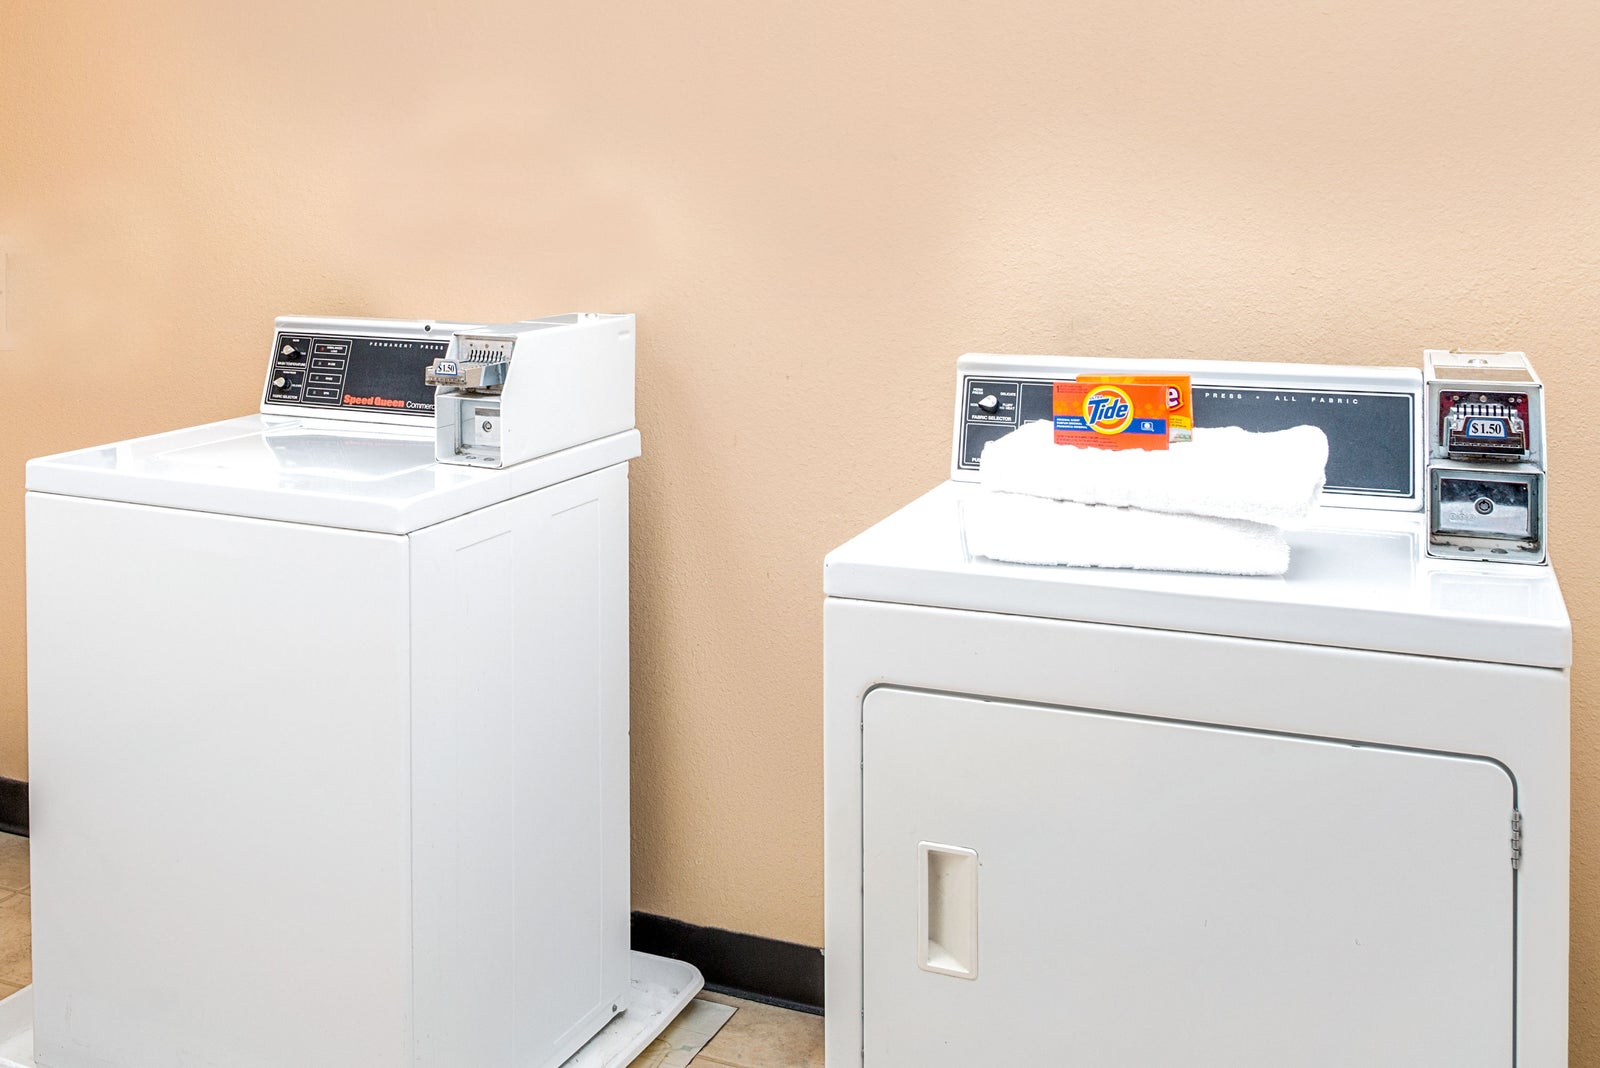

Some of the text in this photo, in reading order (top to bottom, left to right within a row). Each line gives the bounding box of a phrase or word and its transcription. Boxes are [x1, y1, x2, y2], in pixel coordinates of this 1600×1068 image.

[438, 364, 455, 373] $1.50
[343, 394, 374, 406] Speed
[374, 396, 405, 408] Queen
[1087, 397, 1129, 425] Tide
